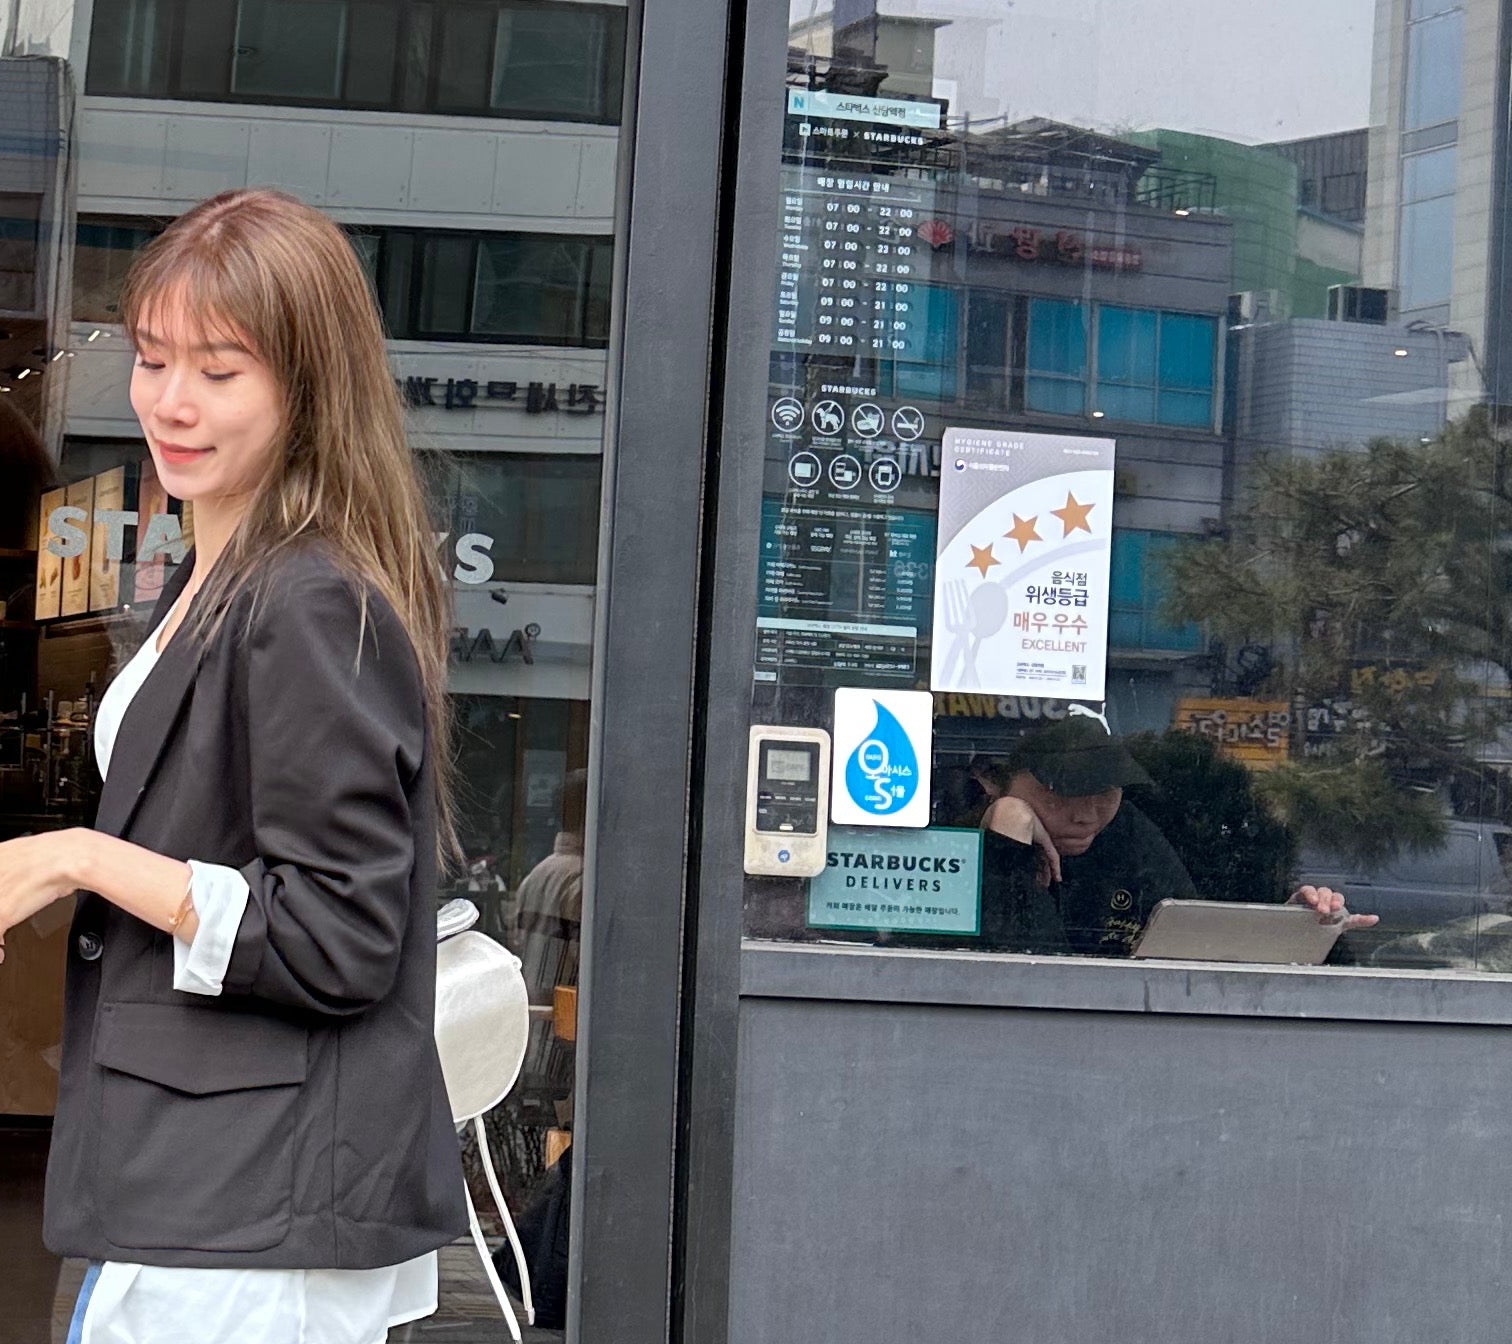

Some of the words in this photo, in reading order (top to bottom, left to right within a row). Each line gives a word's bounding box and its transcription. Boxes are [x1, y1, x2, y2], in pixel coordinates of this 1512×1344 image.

[863, 131, 924, 145] STARBUCKS
[821, 384, 876, 396] STARBUCKS
[1051, 570, 1088, 587] 음식점
[1025, 585, 1089, 607] 위생등급
[1013, 611, 1049, 634] 매우
[1051, 613, 1089, 636] 우수
[1021, 638, 1088, 653] EXCELLENT
[827, 852, 961, 874] STARBUCKS
[846, 875, 942, 892] DELIVERS
